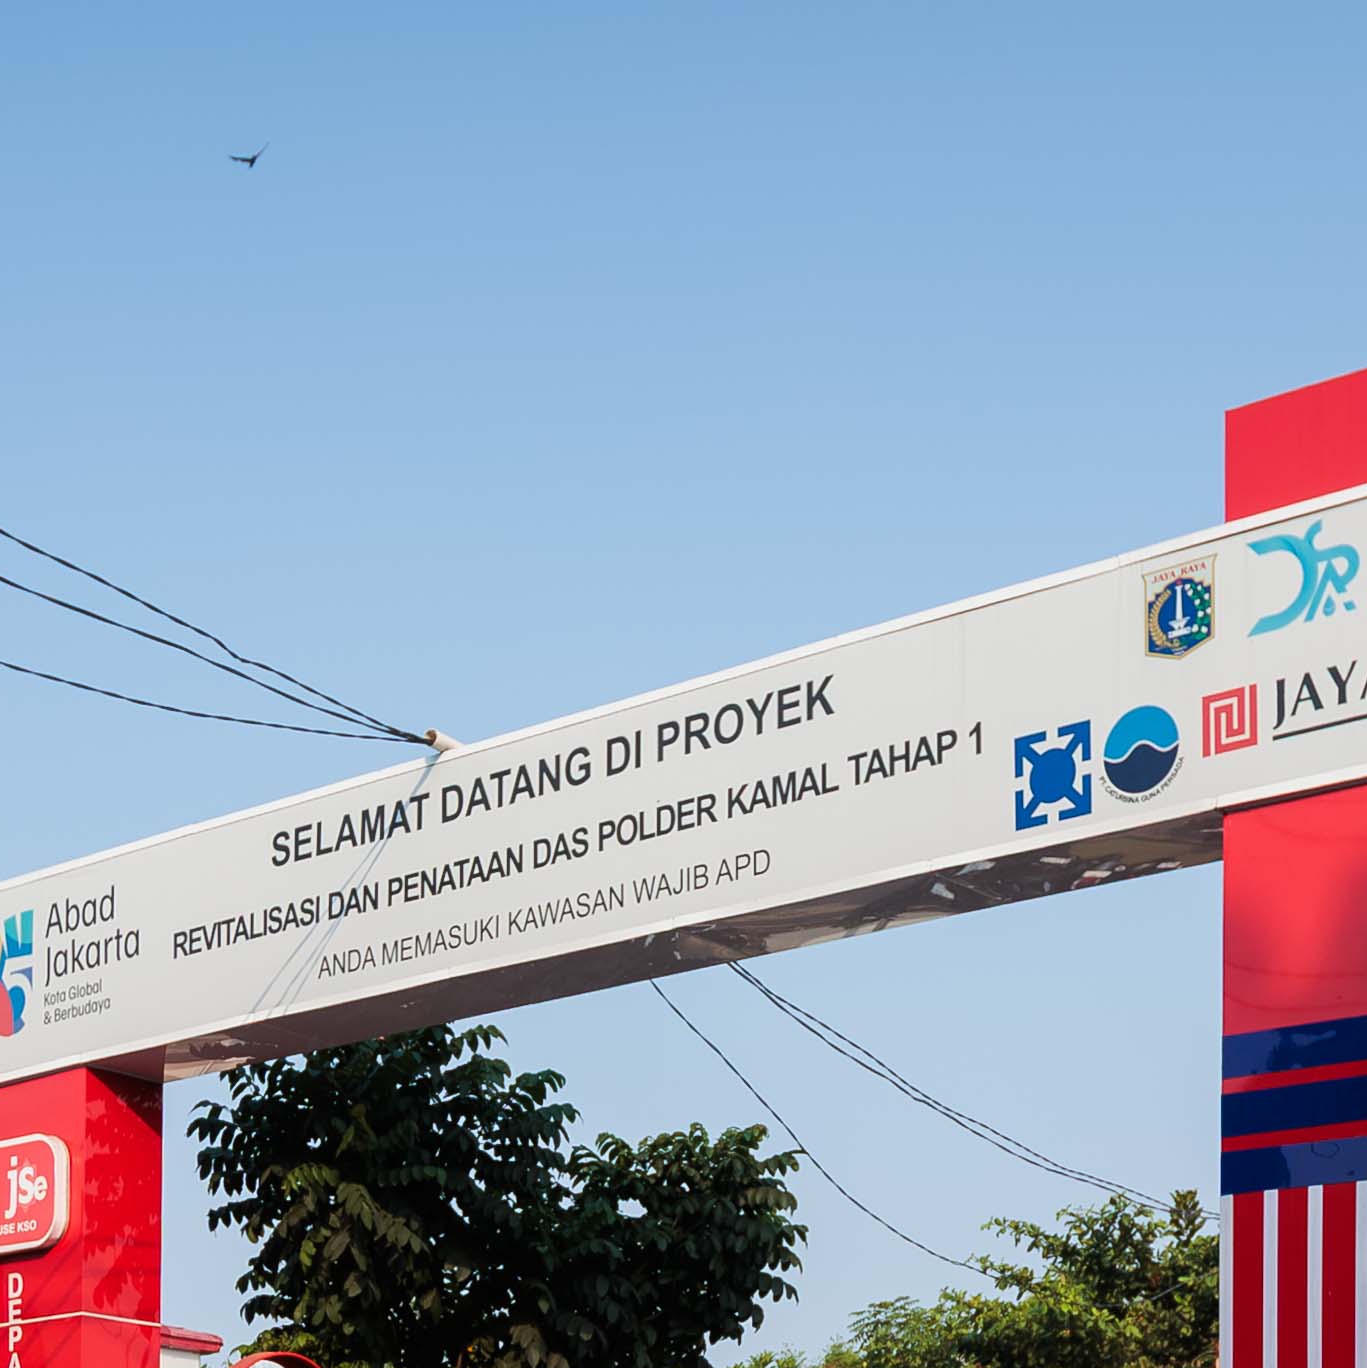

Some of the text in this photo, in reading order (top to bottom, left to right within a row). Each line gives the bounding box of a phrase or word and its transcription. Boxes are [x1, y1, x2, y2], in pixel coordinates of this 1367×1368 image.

[271, 674, 835, 868] SELAMAT DATANG DI PROYEK
[173, 722, 983, 960] REVITALISASI DAN PENATAAN DAS POLDER KAMAL TAHAP 1
[45, 884, 115, 939] Abad
[318, 848, 771, 980] ANDA MEMASUKI KAWASAN WAJIB APD
[45, 928, 140, 988] Jakarta
[43, 998, 111, 1025] & Berbudaya
[44, 978, 103, 1007] Kota Global
[17, 1219, 37, 1232] KSO
